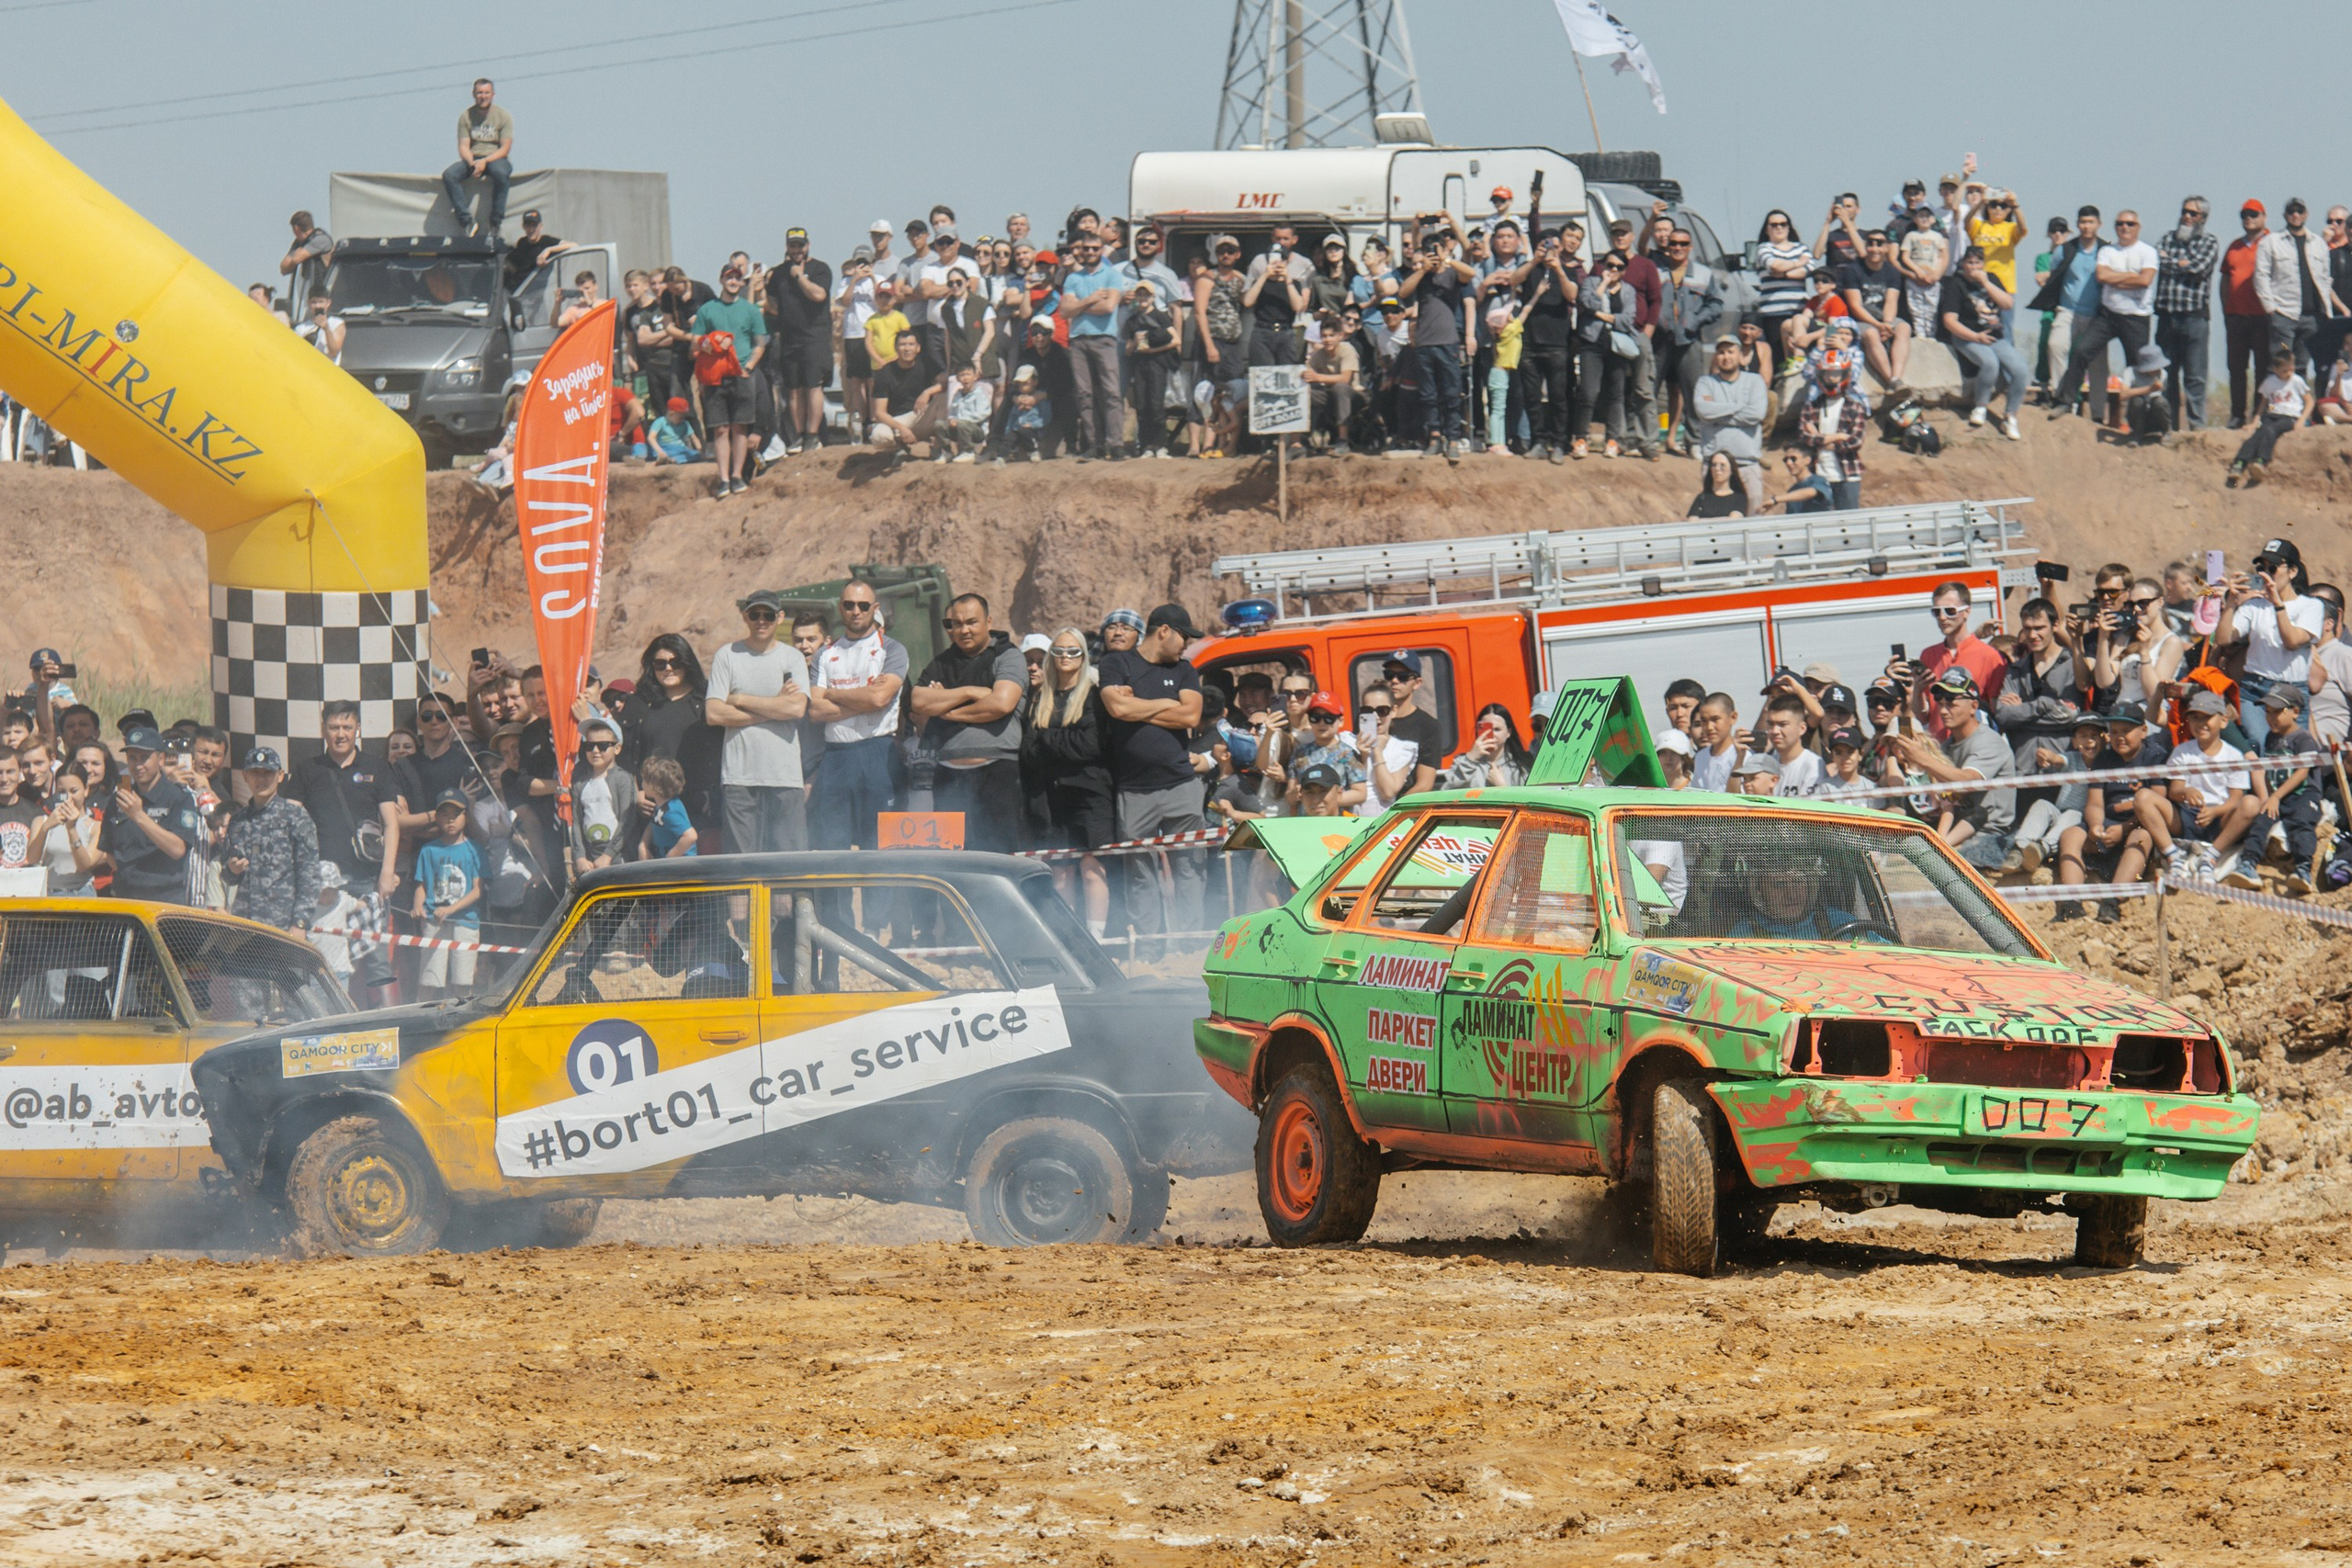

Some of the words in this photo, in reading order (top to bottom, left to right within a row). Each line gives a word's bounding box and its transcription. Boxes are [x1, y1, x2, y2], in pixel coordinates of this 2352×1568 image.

[1235, 193, 1285, 209] LMC
[543, 360, 605, 401] Зарядись
[563, 406, 581, 426] на
[1546, 688, 1610, 746] 007
[900, 817, 941, 842] 01
[1359, 954, 1451, 992] ЛАМИНАТ
[1634, 969, 1671, 989] QAMQOR
[1671, 979, 1692, 993] CITY
[1367, 1009, 1436, 1049] ПАРКЕТ
[1462, 999, 1535, 1041] ЛАМИНАТ
[289, 1045, 346, 1060] QAMQOR
[351, 1043, 379, 1054] CITY
[575, 1036, 647, 1089] 01
[522, 1005, 1029, 1169] #bort01_car_service
[1366, 1057, 1428, 1094] ДВЕРИ
[1512, 1050, 1571, 1099] ЦЕНТР
[1981, 1095, 2099, 1137] 007
